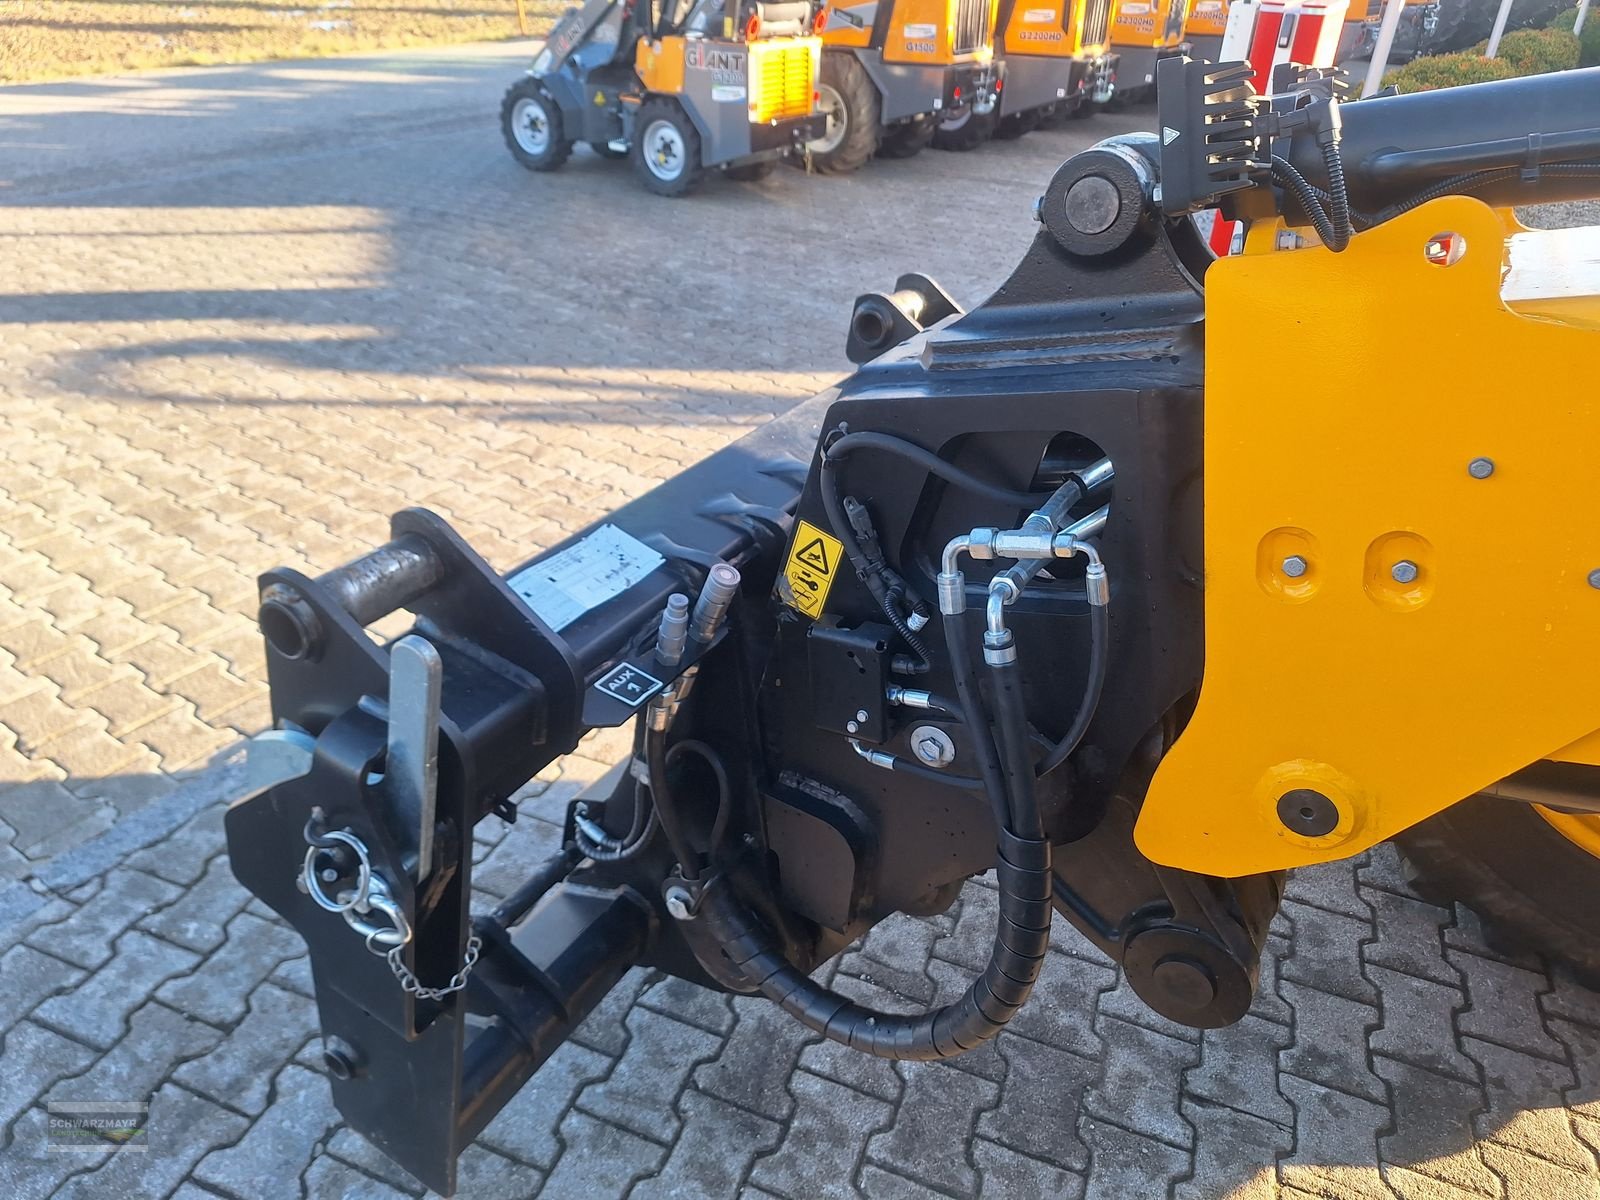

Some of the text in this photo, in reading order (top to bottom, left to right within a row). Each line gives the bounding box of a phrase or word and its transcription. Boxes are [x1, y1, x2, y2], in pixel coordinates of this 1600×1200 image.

[1019, 31, 1062, 41] G2200HD
[905, 41, 936, 53] G1500
[685, 42, 743, 70] GIANT
[608, 669, 636, 691] AUX
